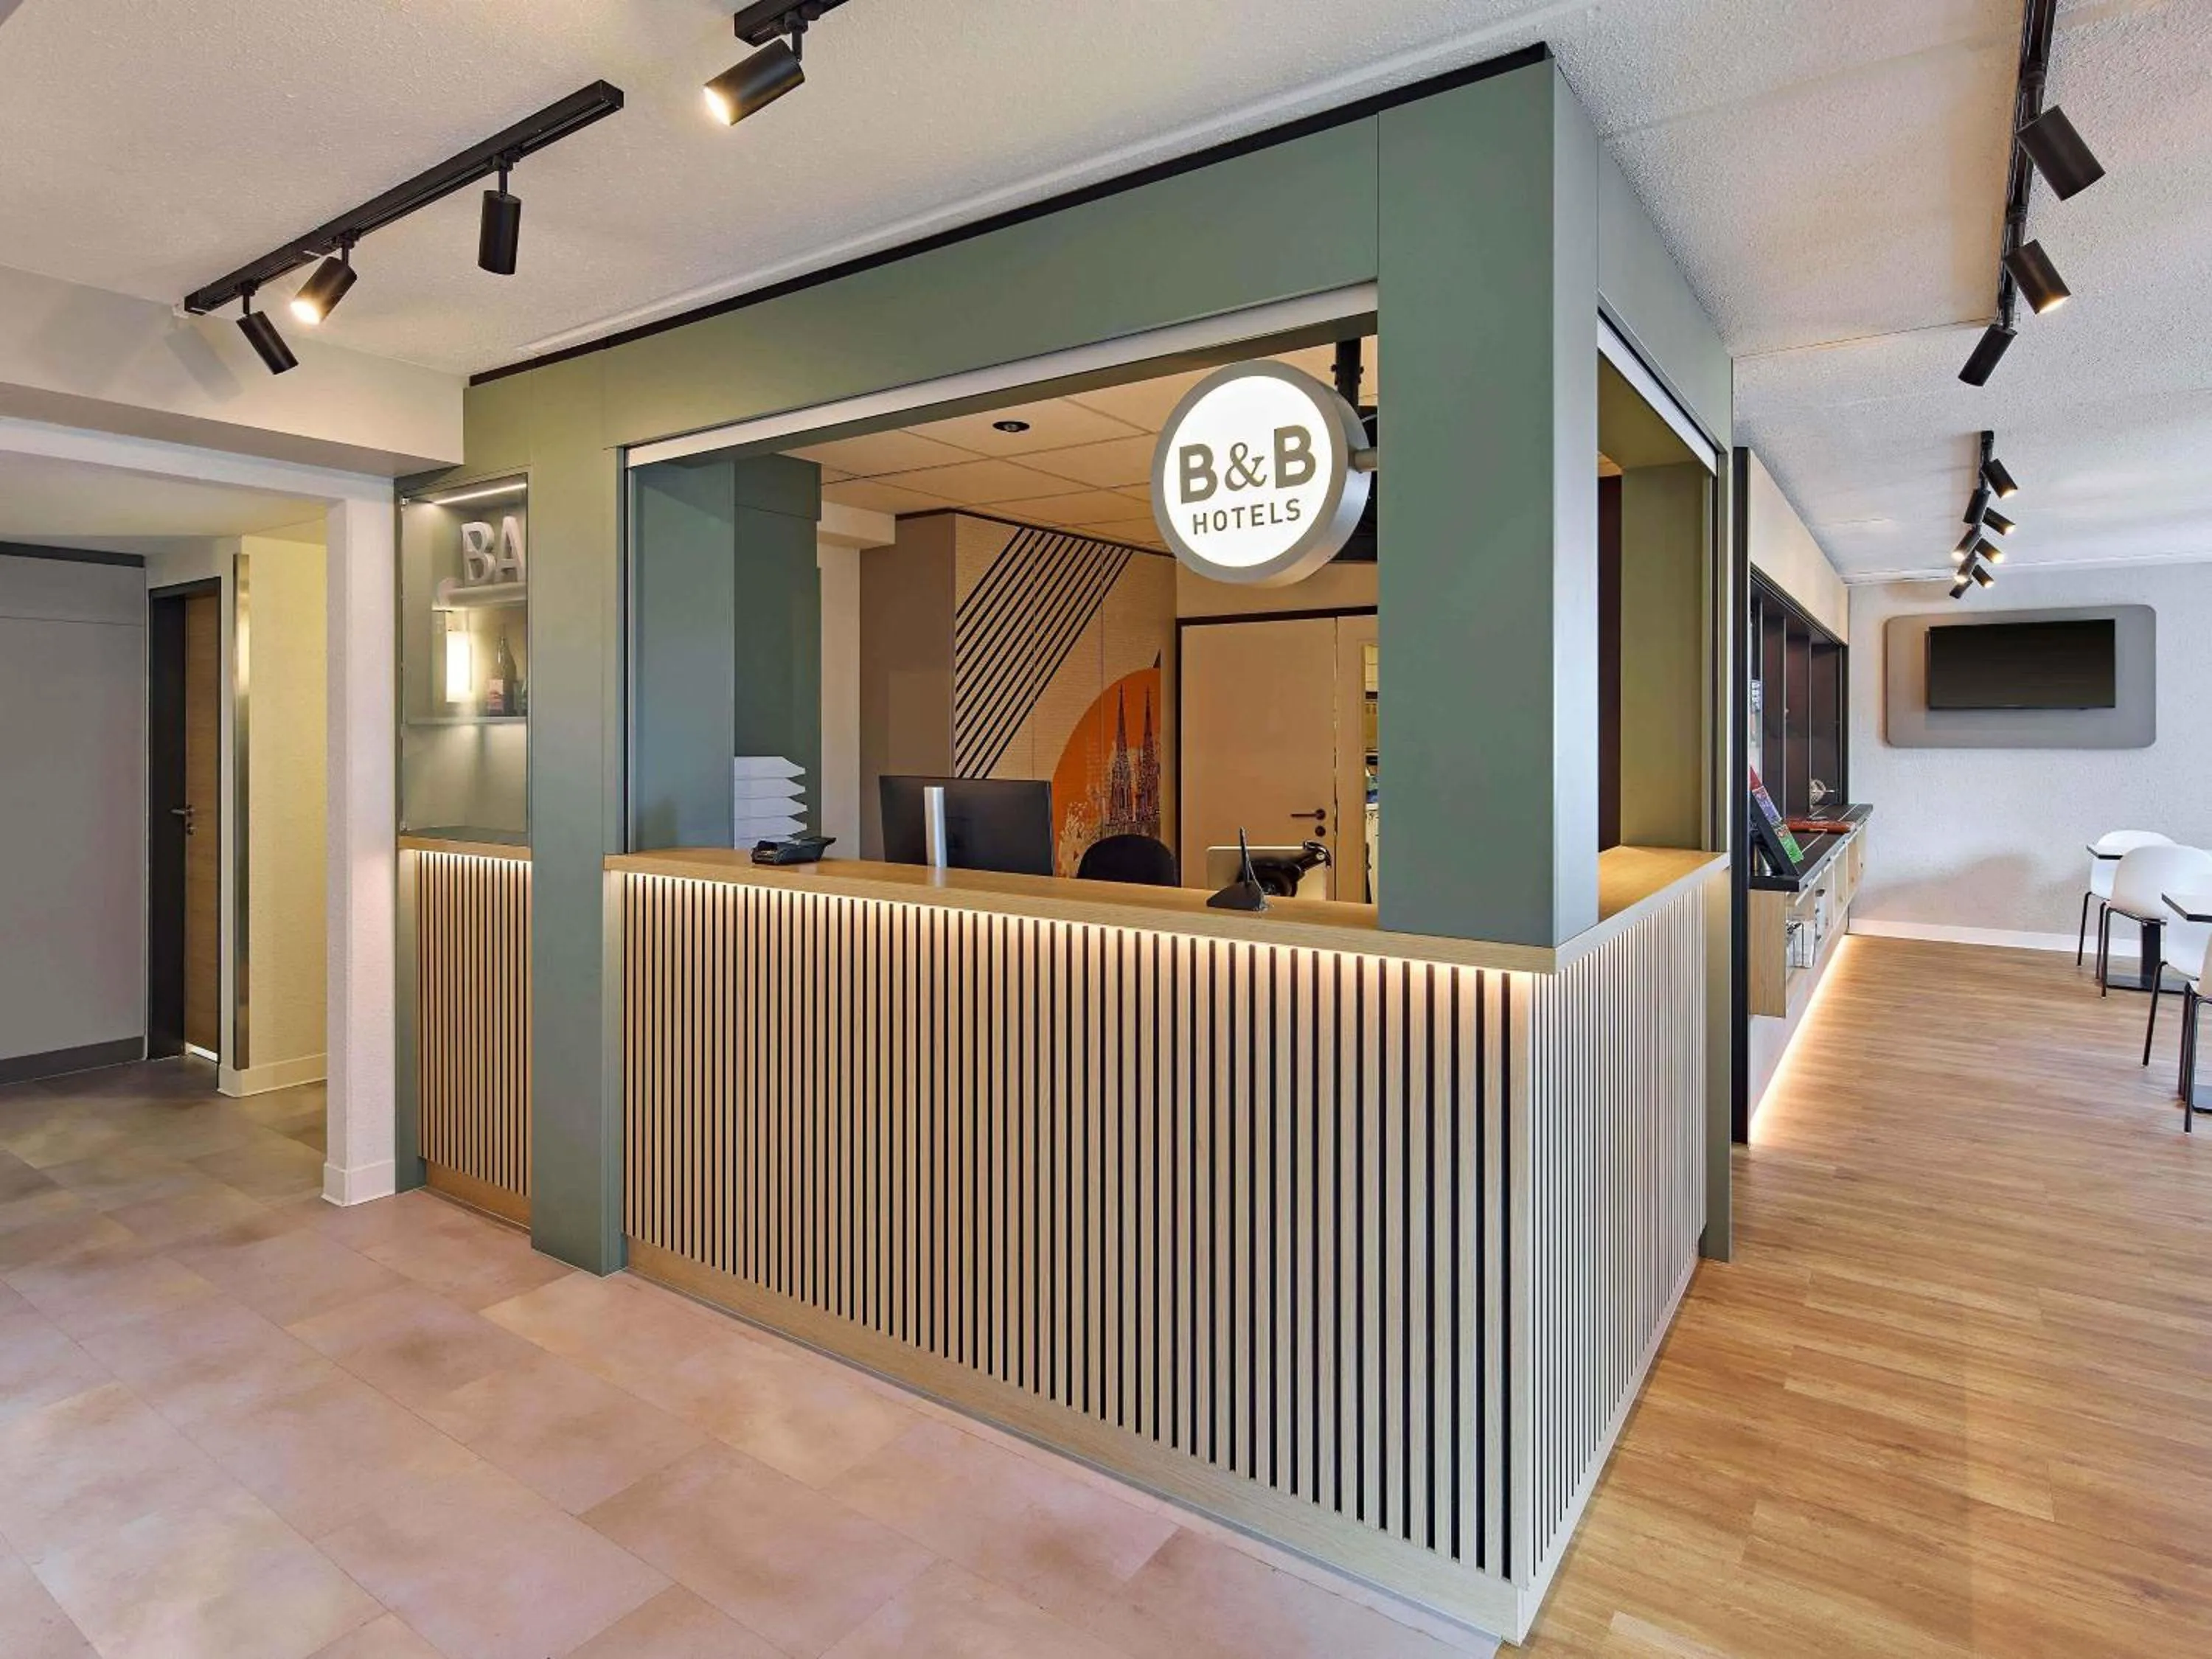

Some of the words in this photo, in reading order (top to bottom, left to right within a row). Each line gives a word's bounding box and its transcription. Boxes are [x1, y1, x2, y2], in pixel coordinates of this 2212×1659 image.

[1179, 424, 1316, 504] B&B
[461, 516, 526, 587] BA
[1192, 498, 1301, 535] HOTELS
